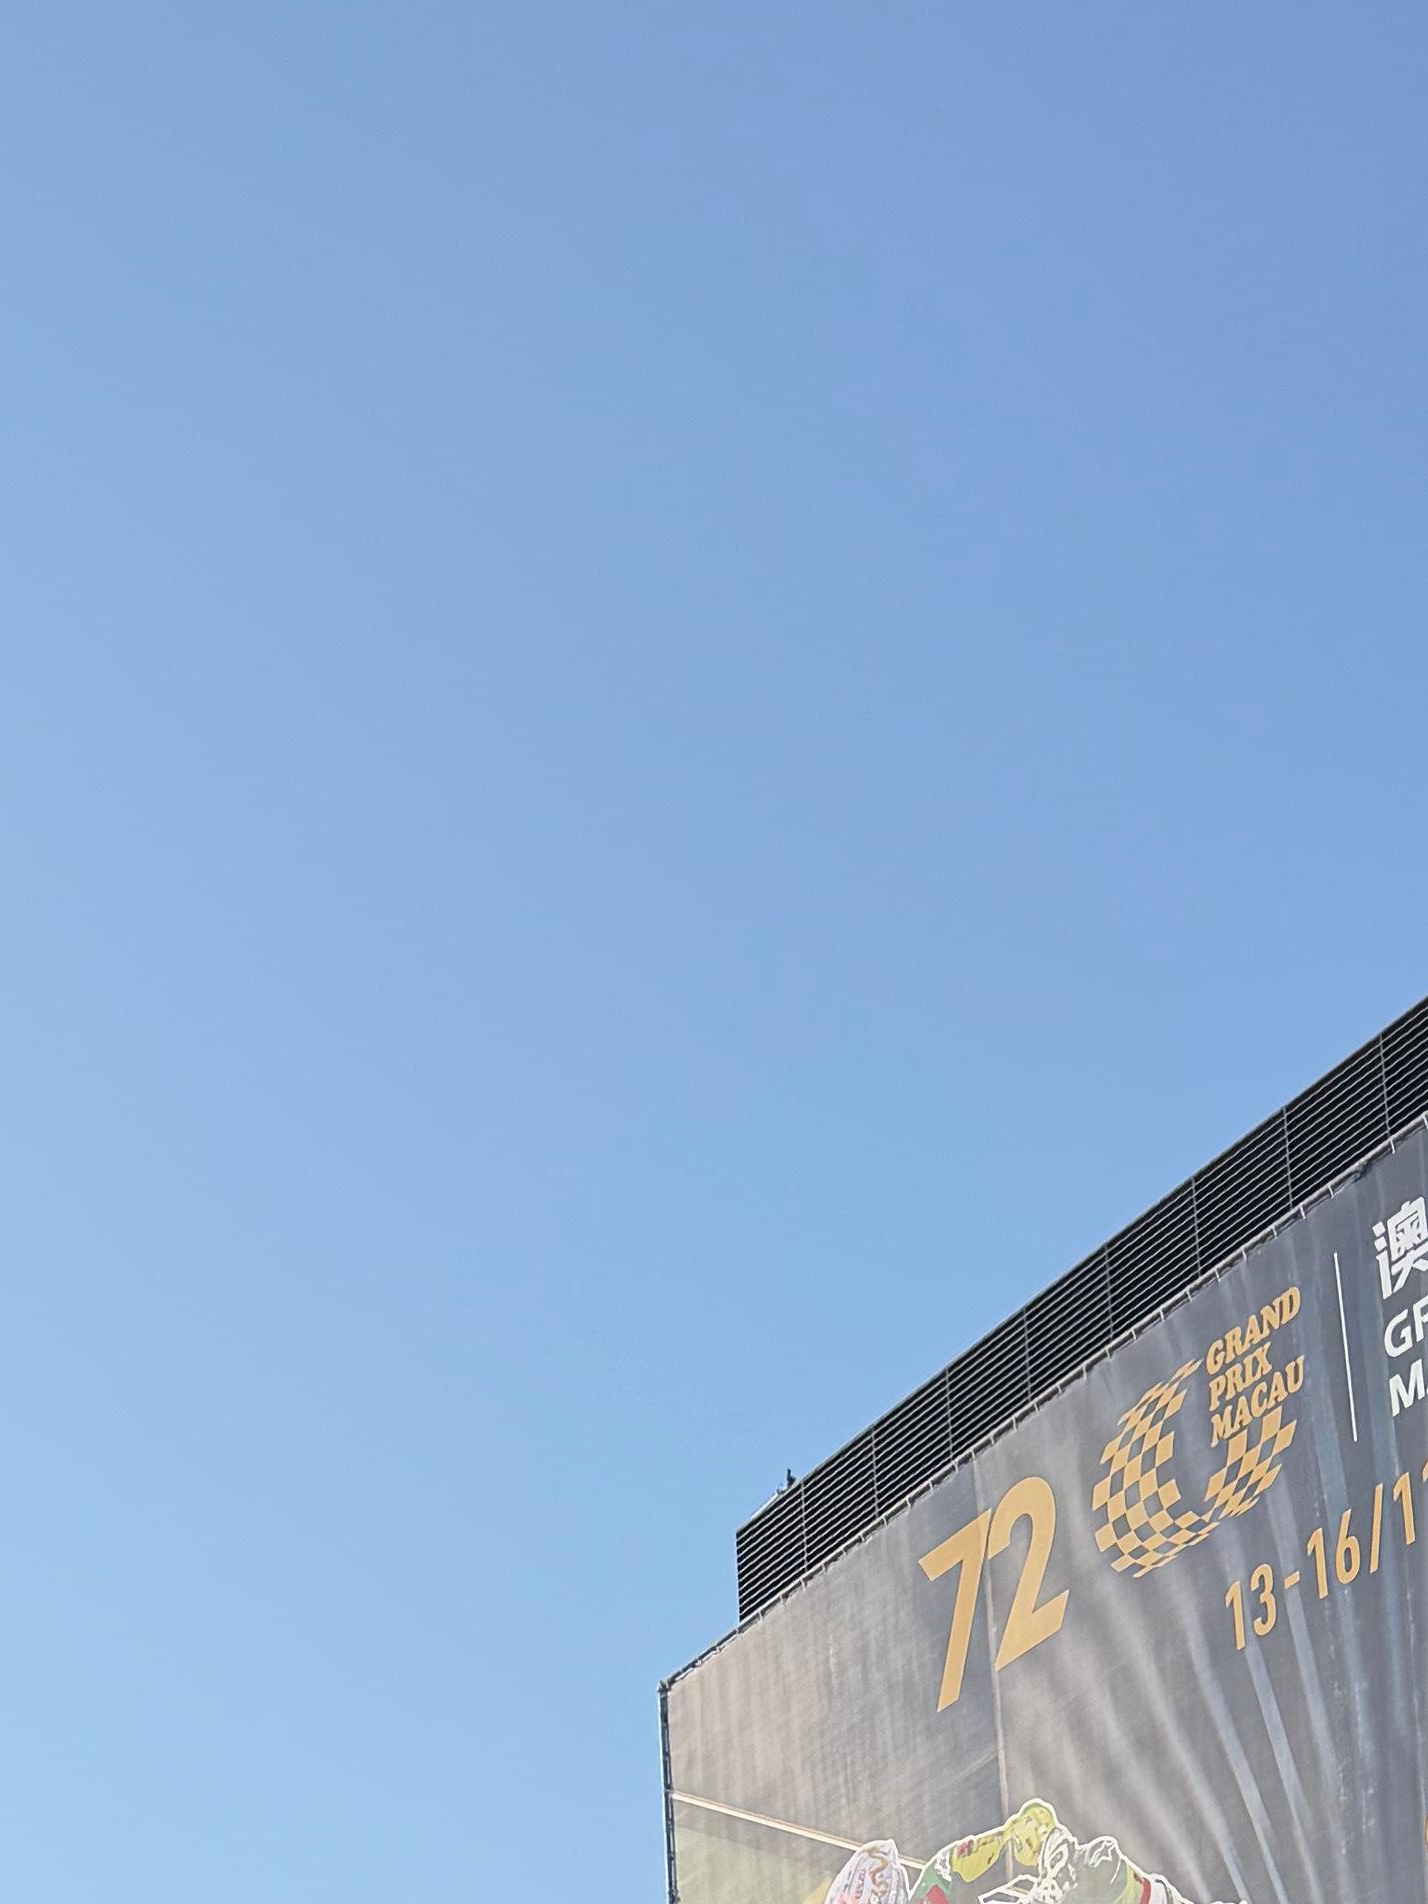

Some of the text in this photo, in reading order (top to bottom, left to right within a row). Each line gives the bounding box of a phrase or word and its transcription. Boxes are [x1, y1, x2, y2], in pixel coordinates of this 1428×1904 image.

[1206, 1287, 1301, 1376] GRAND
[1208, 1346, 1272, 1412] PRIX
[1210, 1356, 1304, 1447] MACAU
[918, 1476, 1070, 1712] 72
